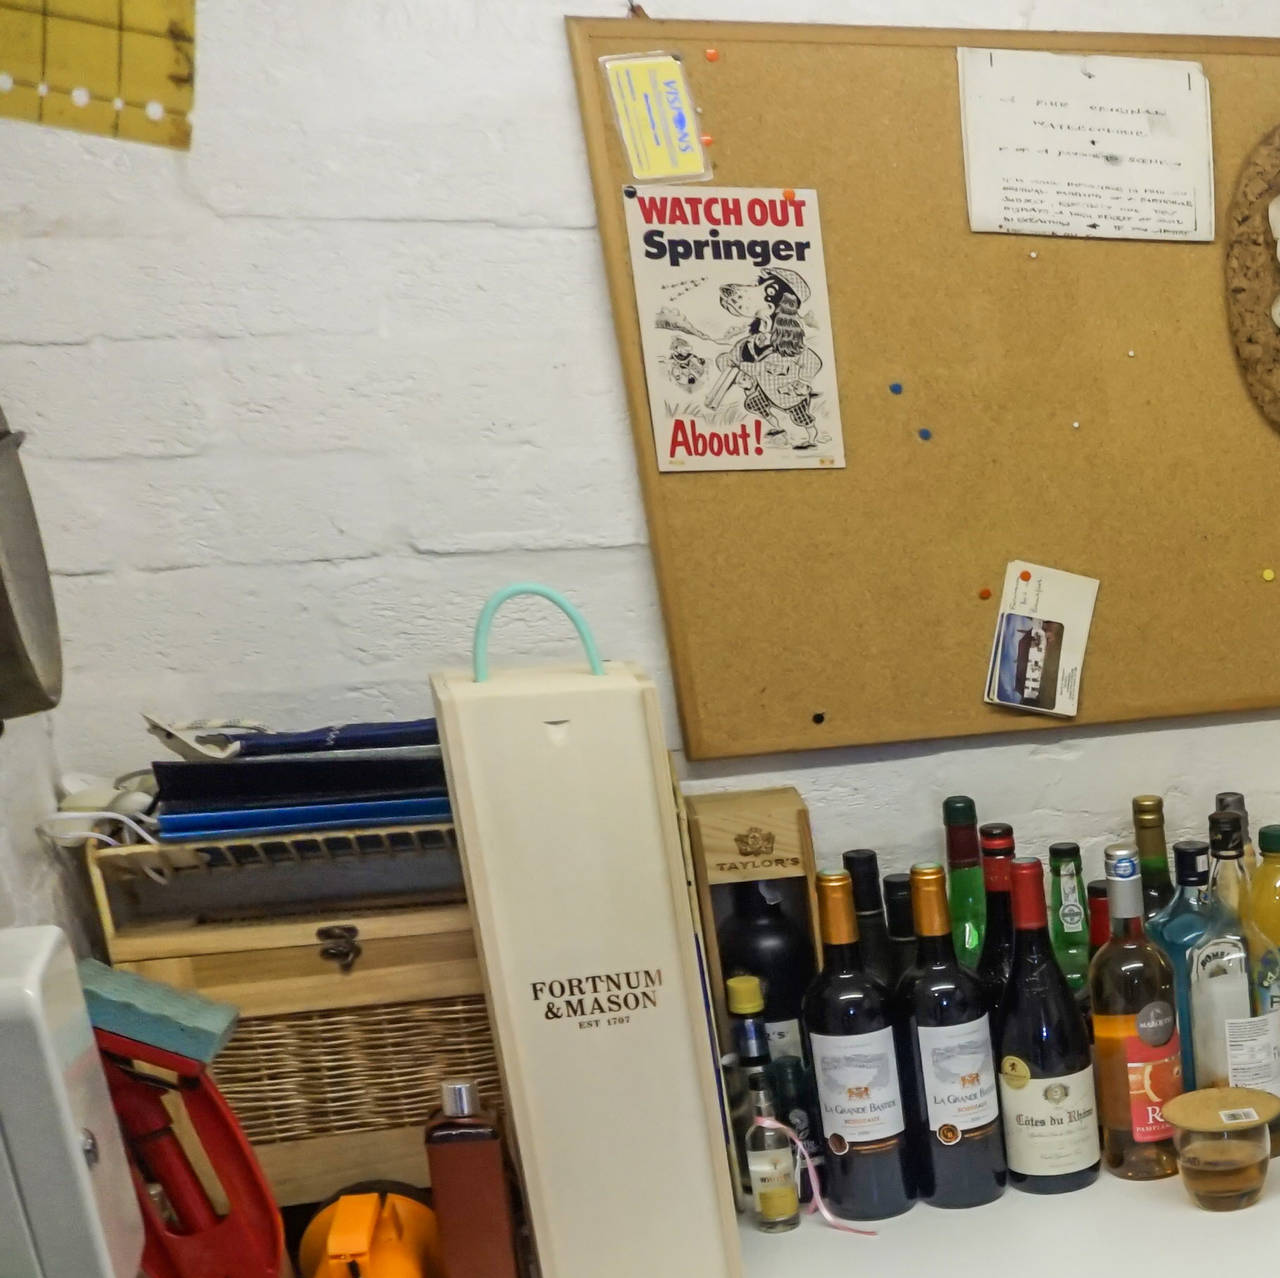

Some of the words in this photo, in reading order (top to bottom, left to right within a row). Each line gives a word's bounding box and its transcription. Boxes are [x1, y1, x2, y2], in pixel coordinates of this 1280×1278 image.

[636, 196, 743, 226] WATCH
[747, 198, 806, 227] OUT
[643, 229, 811, 267] Springer
[669, 419, 764, 458] About!
[716, 857, 800, 871] TAYLOR'S
[530, 969, 662, 1001] FORTNUM
[578, 1019, 600, 1029] EST
[607, 1016, 630, 1026] 1707
[933, 1095, 946, 1106] LA
[947, 1092, 978, 1106] GRANDE
[838, 1103, 866, 1115] GRANDE
[1050, 1114, 1065, 1126] du
